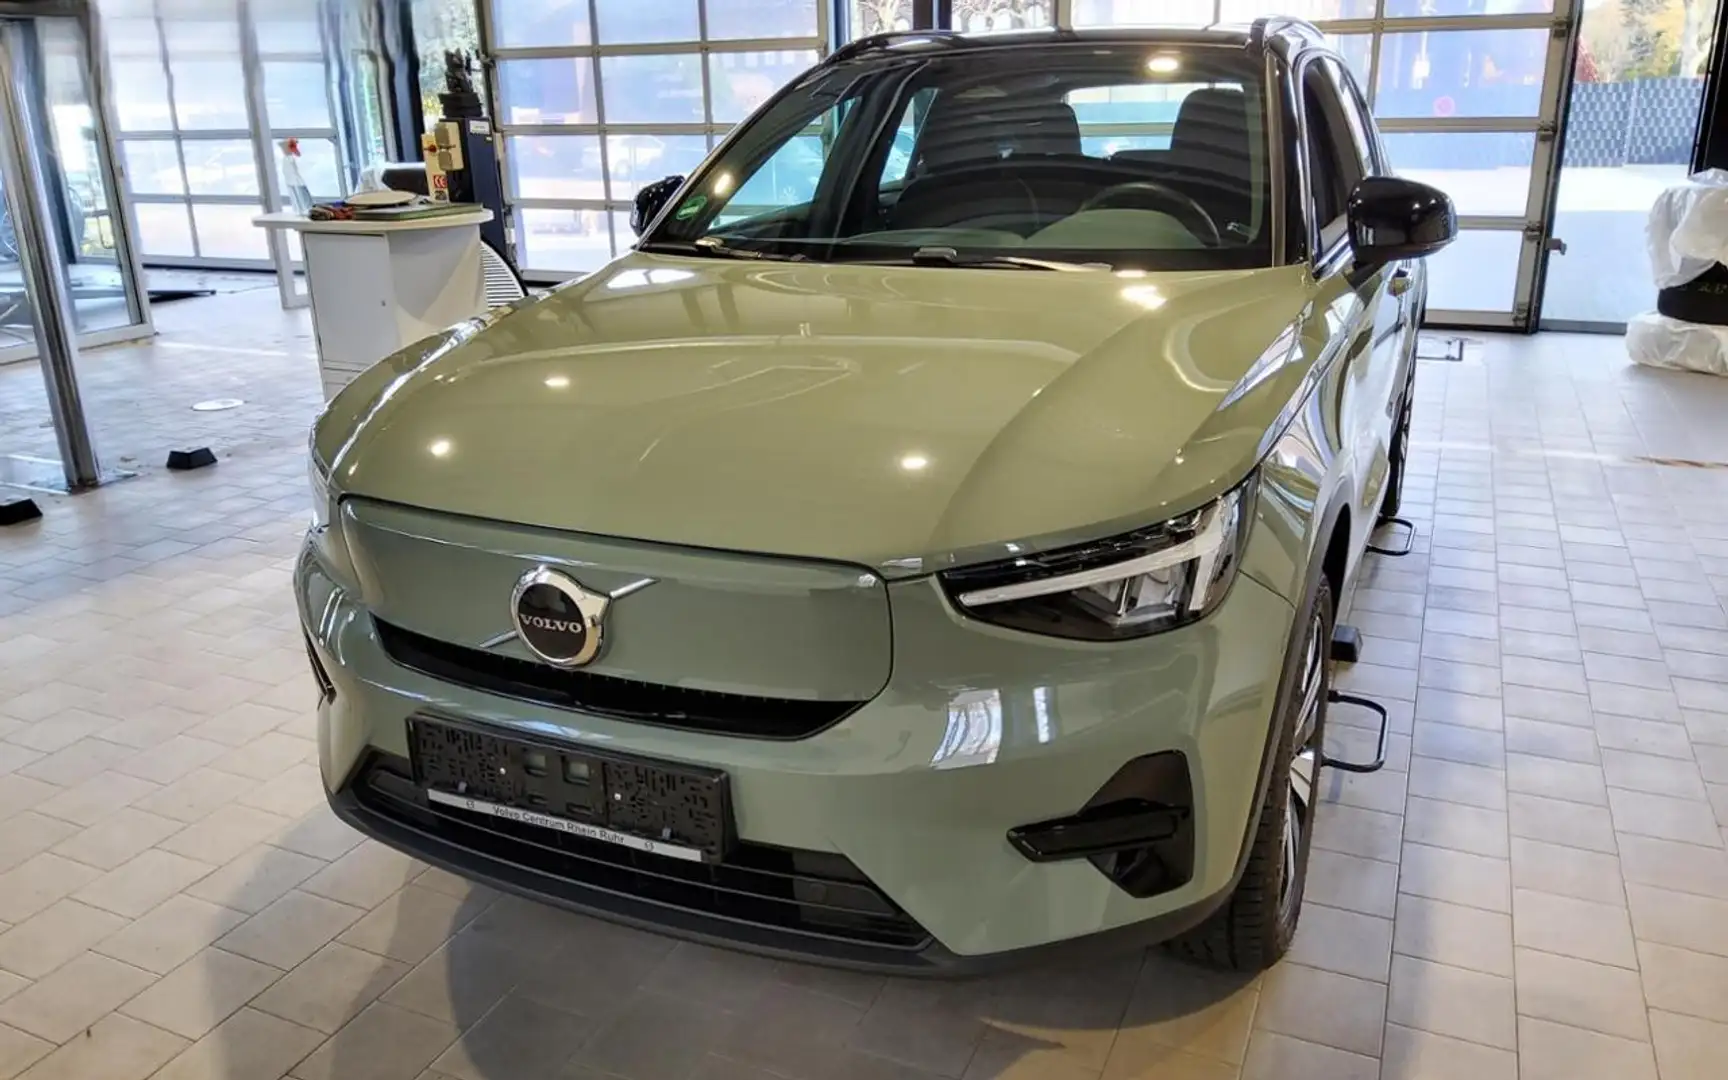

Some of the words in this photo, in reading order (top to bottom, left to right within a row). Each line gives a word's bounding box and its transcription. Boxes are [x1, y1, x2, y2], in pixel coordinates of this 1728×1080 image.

[519, 614, 582, 633] VOLVO
[493, 805, 521, 820] Volvo
[522, 811, 566, 831] Centrum
[567, 822, 597, 838] Rhein
[599, 829, 625, 844] Ruhr
